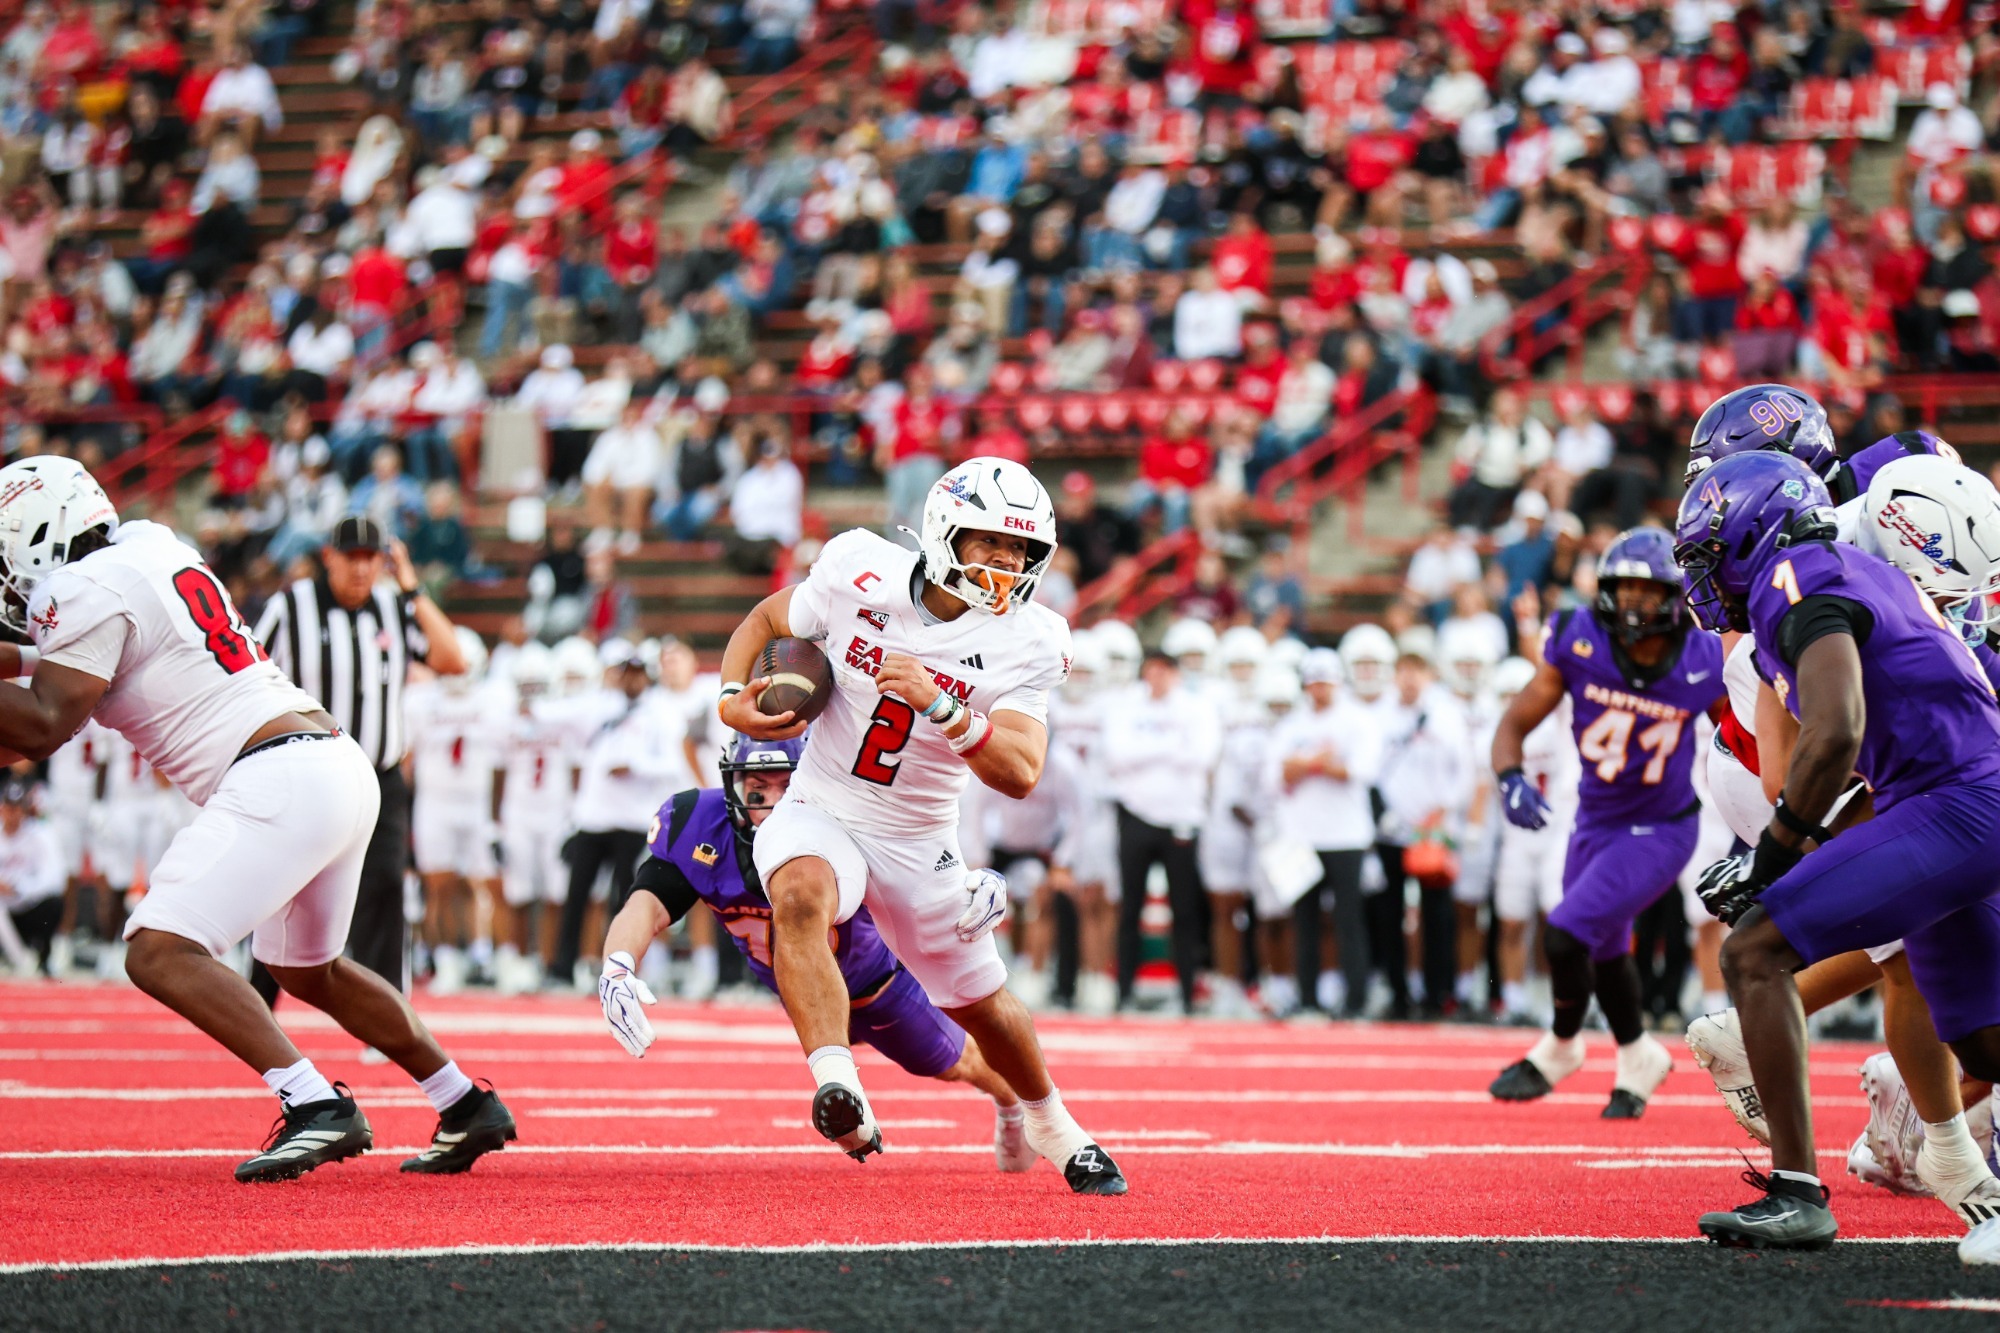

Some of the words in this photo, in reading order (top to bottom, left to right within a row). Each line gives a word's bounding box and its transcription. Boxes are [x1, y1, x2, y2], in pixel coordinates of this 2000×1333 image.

[1749, 391, 1803, 437] 90
[1699, 476, 1724, 511] 1
[1003, 515, 1036, 533] EKG
[853, 571, 882, 593] C
[1771, 559, 1803, 606] 1
[869, 611, 890, 625] SKY
[850, 694, 915, 787] 2
[1580, 707, 1684, 785] 41
